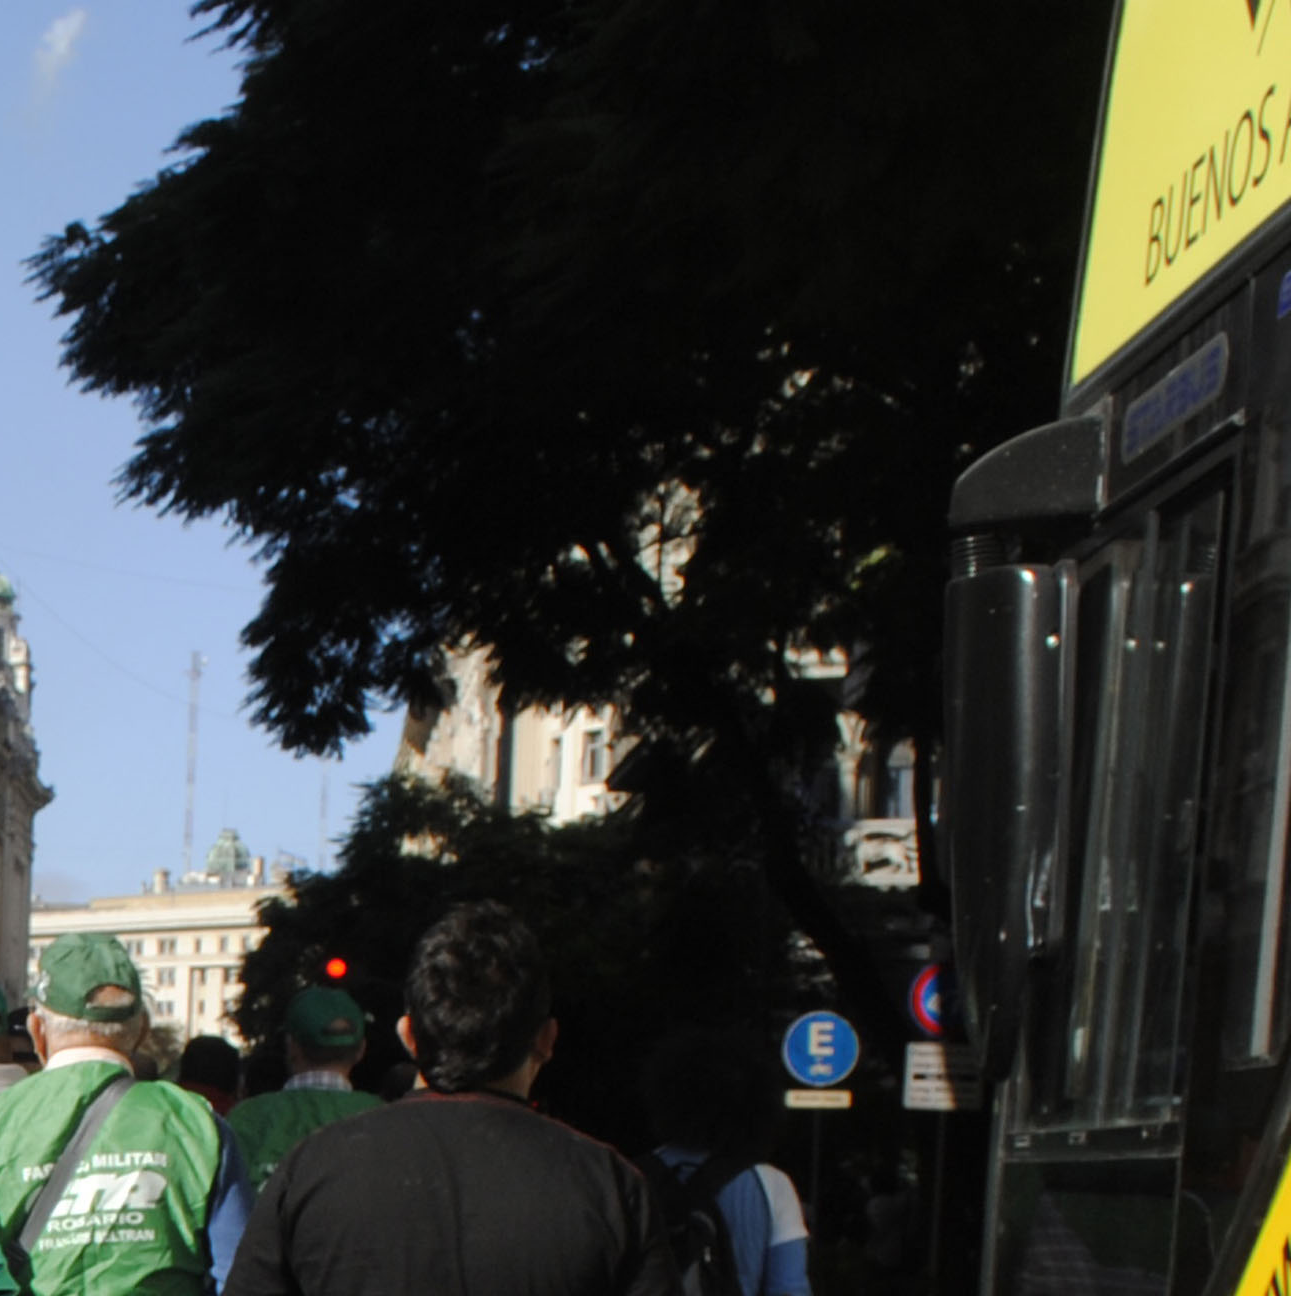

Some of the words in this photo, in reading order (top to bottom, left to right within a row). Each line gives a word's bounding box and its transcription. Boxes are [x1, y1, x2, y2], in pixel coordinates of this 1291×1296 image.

[1144, 83, 1276, 288] BUENOS
[809, 1020, 835, 1056] E
[46, 1211, 145, 1233] ROSARIO
